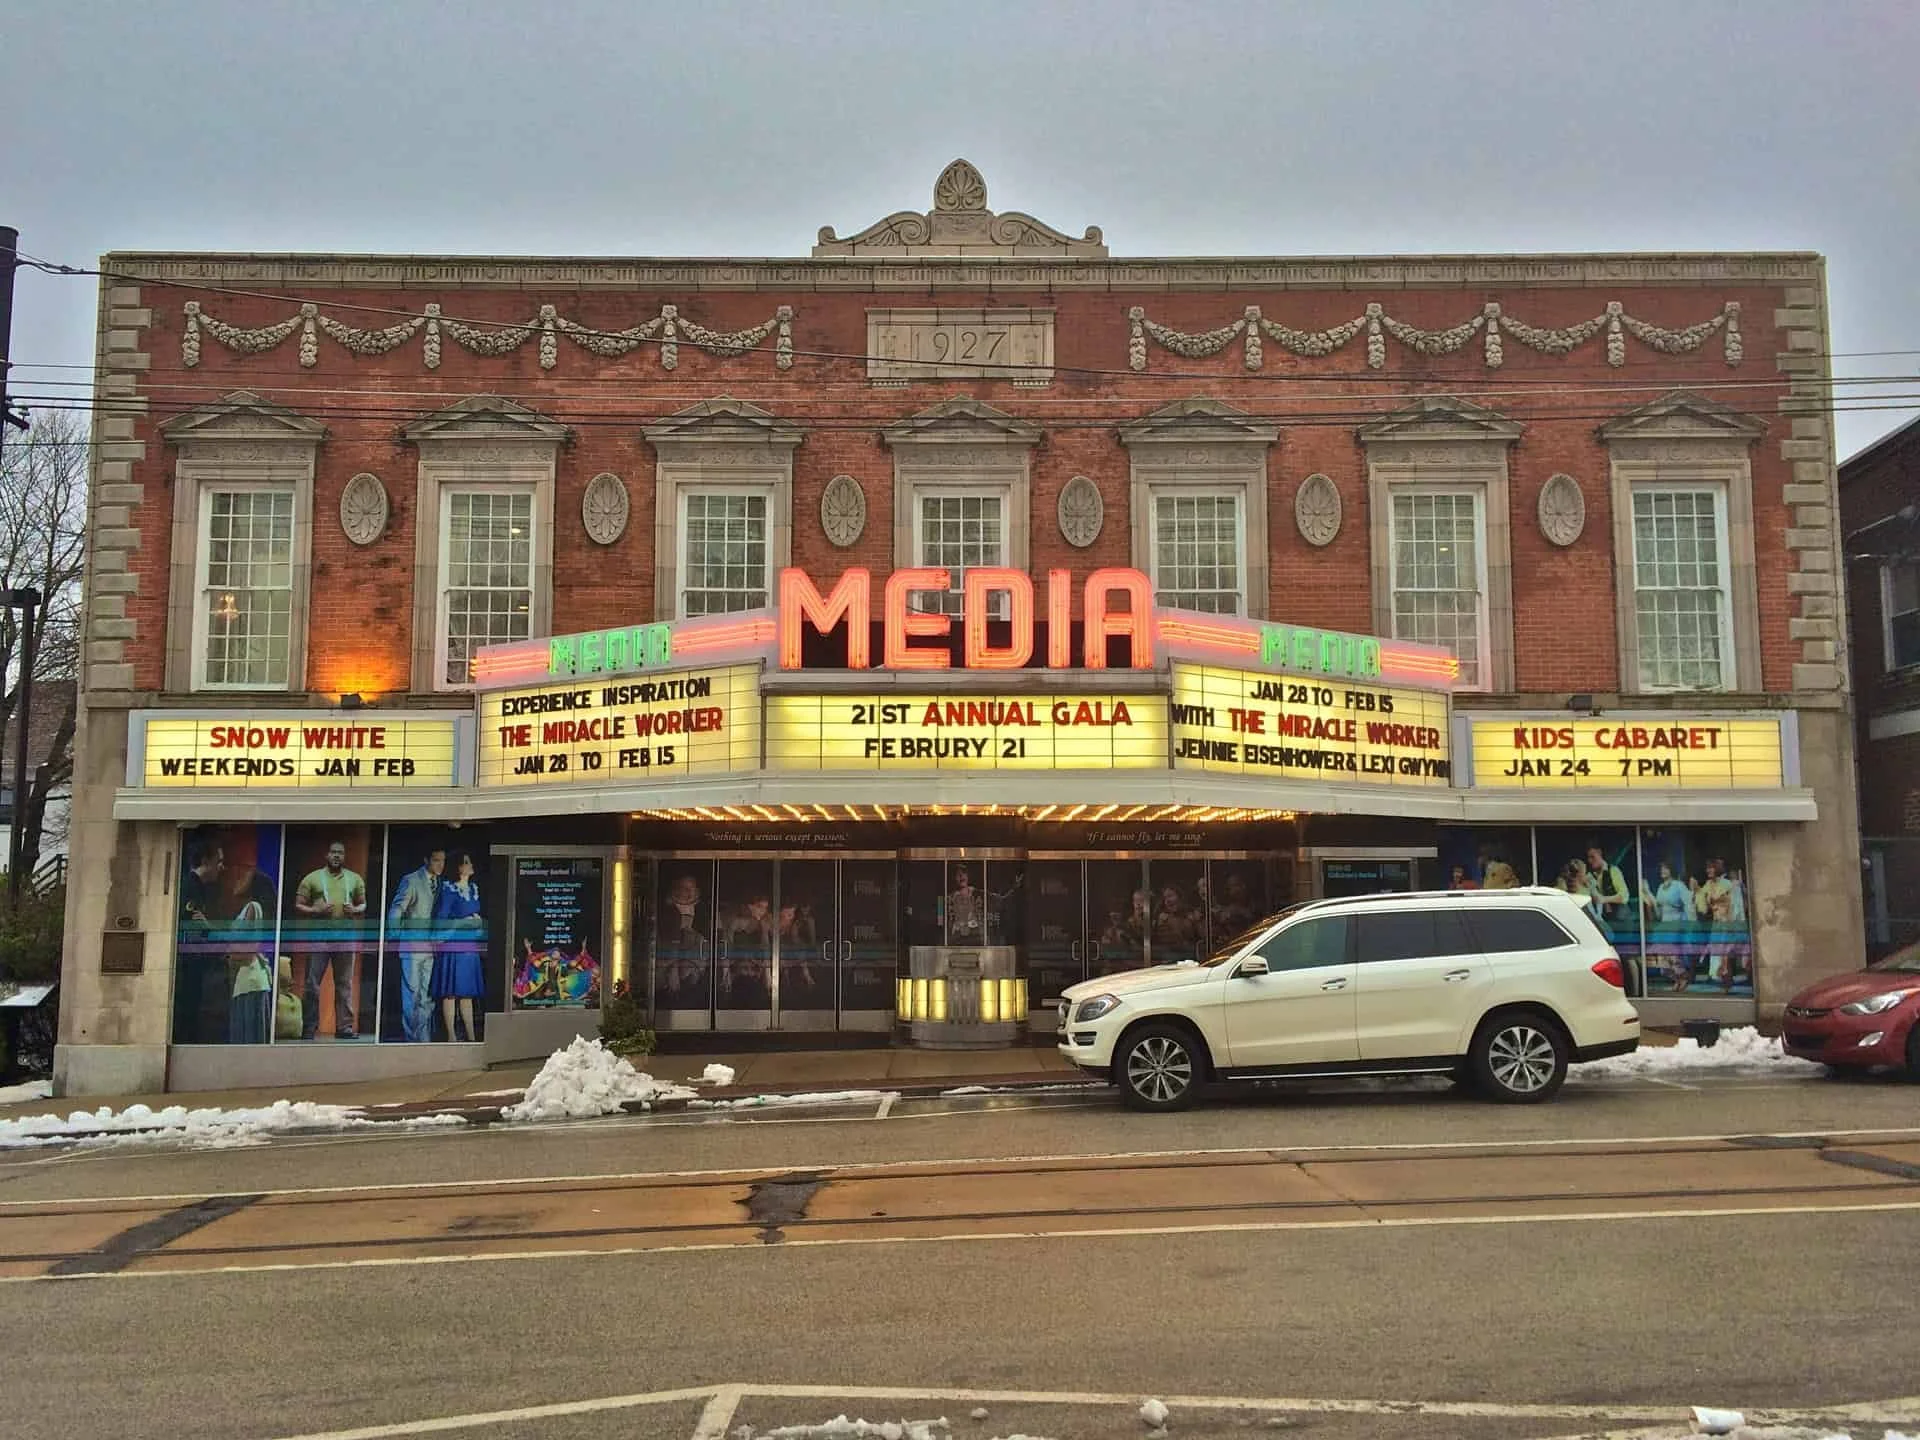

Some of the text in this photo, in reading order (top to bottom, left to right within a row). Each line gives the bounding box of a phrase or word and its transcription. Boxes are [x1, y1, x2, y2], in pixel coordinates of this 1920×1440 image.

[914, 331, 1008, 362] 1927
[779, 567, 1153, 669] MEDIA
[549, 623, 671, 675] MEDIA
[1262, 625, 1382, 676] MEDIA
[502, 677, 711, 717] EXPERIENCE INSPIRATION
[1251, 680, 1394, 713] JAN 28 TO FEB 15
[499, 706, 723, 748] THE MIRACLE WORKER
[851, 701, 1133, 727] 21ST ANNUAL GALA
[1171, 703, 1440, 750] WITH THE MIRACLE WORKER
[209, 726, 386, 749] SNOW WHITE
[1002, 738, 1026, 758] 21
[1513, 727, 1721, 750] KIDS CABARET
[160, 758, 415, 776] WEEKENDS JAN FEB
[514, 746, 675, 775] JAN 28 TO FEB 15
[1175, 738, 1238, 763] JENNIE
[1362, 753, 1394, 775] LEXI
[1504, 759, 1672, 777] JAN 24 7 PM
